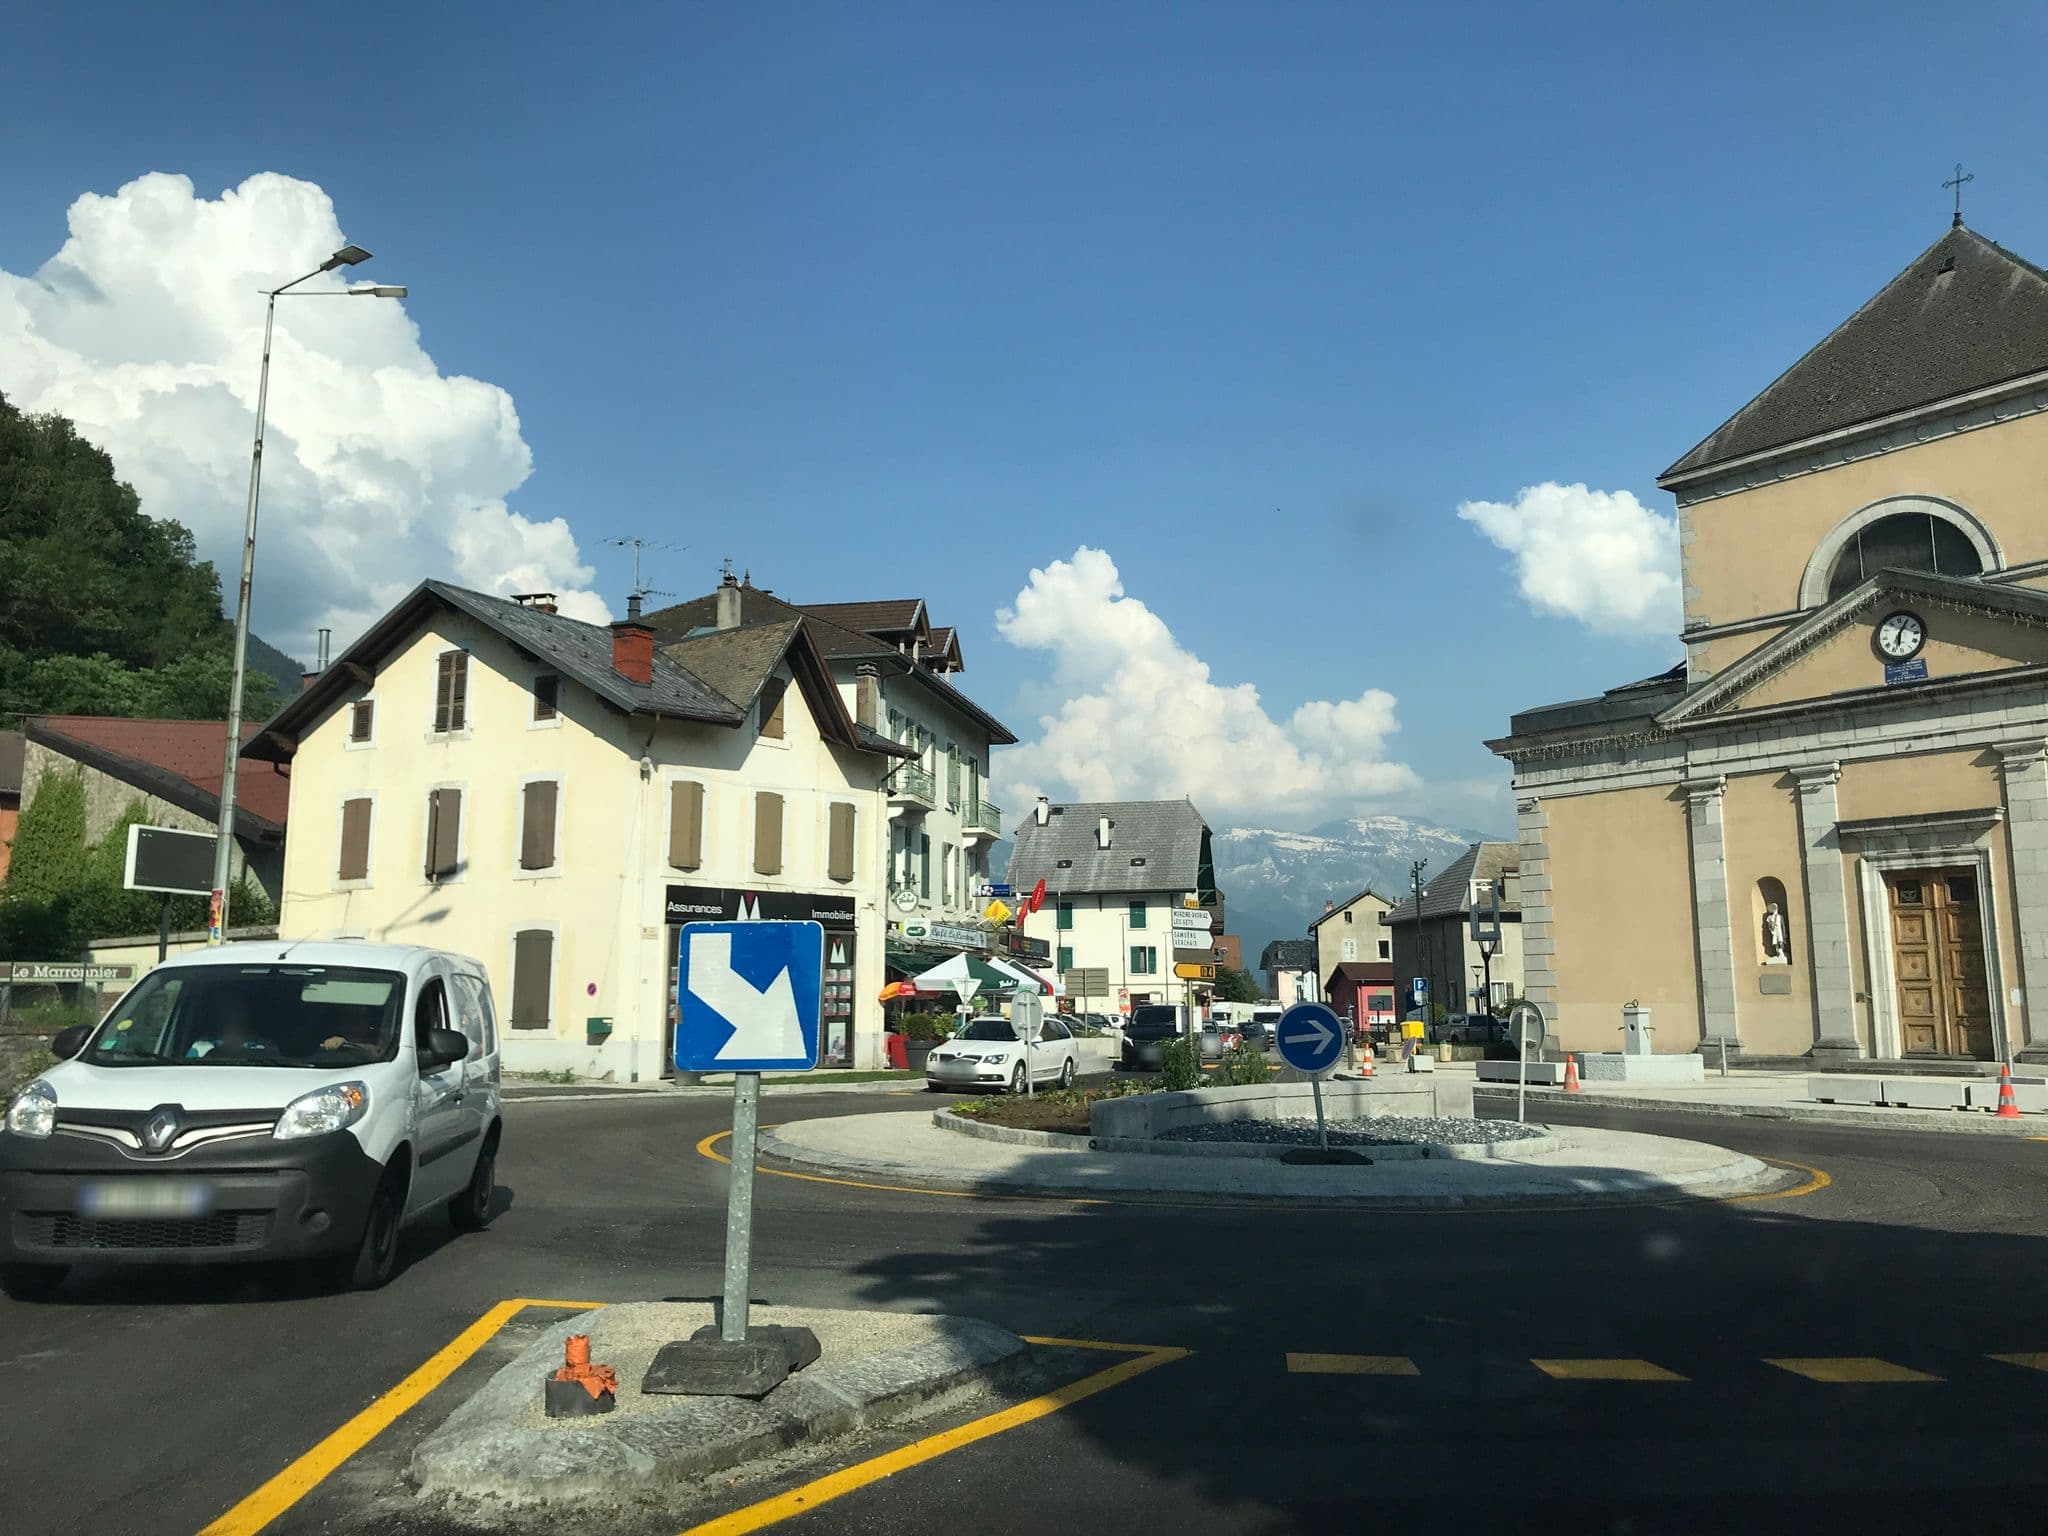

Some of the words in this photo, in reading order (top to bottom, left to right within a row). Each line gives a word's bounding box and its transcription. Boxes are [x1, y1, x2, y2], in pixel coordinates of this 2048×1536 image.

[667, 901, 723, 914] Assurances
[811, 909, 855, 921] Immobilier
[12, 965, 29, 978] Le
[33, 965, 119, 978] Marronnier
